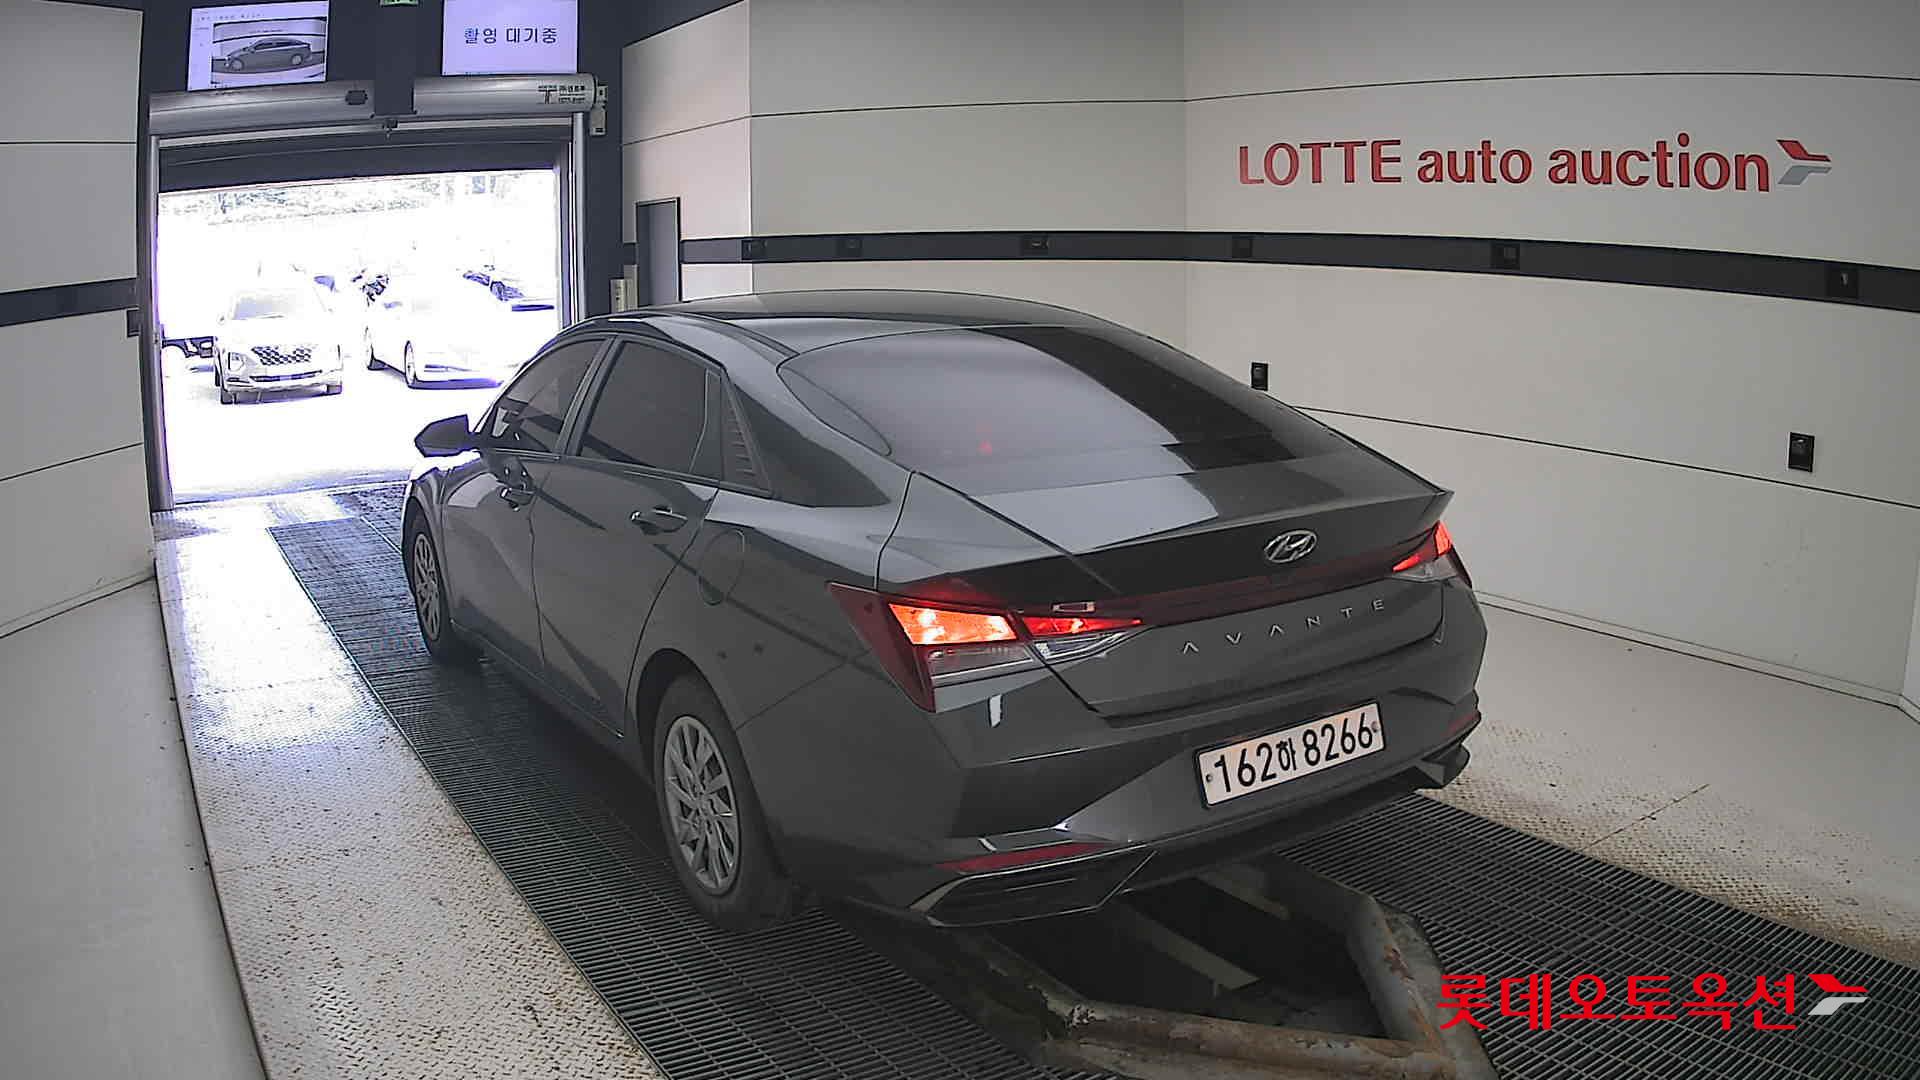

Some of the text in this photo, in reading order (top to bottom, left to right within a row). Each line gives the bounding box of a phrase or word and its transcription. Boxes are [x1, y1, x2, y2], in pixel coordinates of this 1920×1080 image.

[464, 27, 558, 44] 촬영 대기중
[1239, 132, 1771, 192] LOTTE auto auction
[1183, 599, 1385, 654] AVANTE
